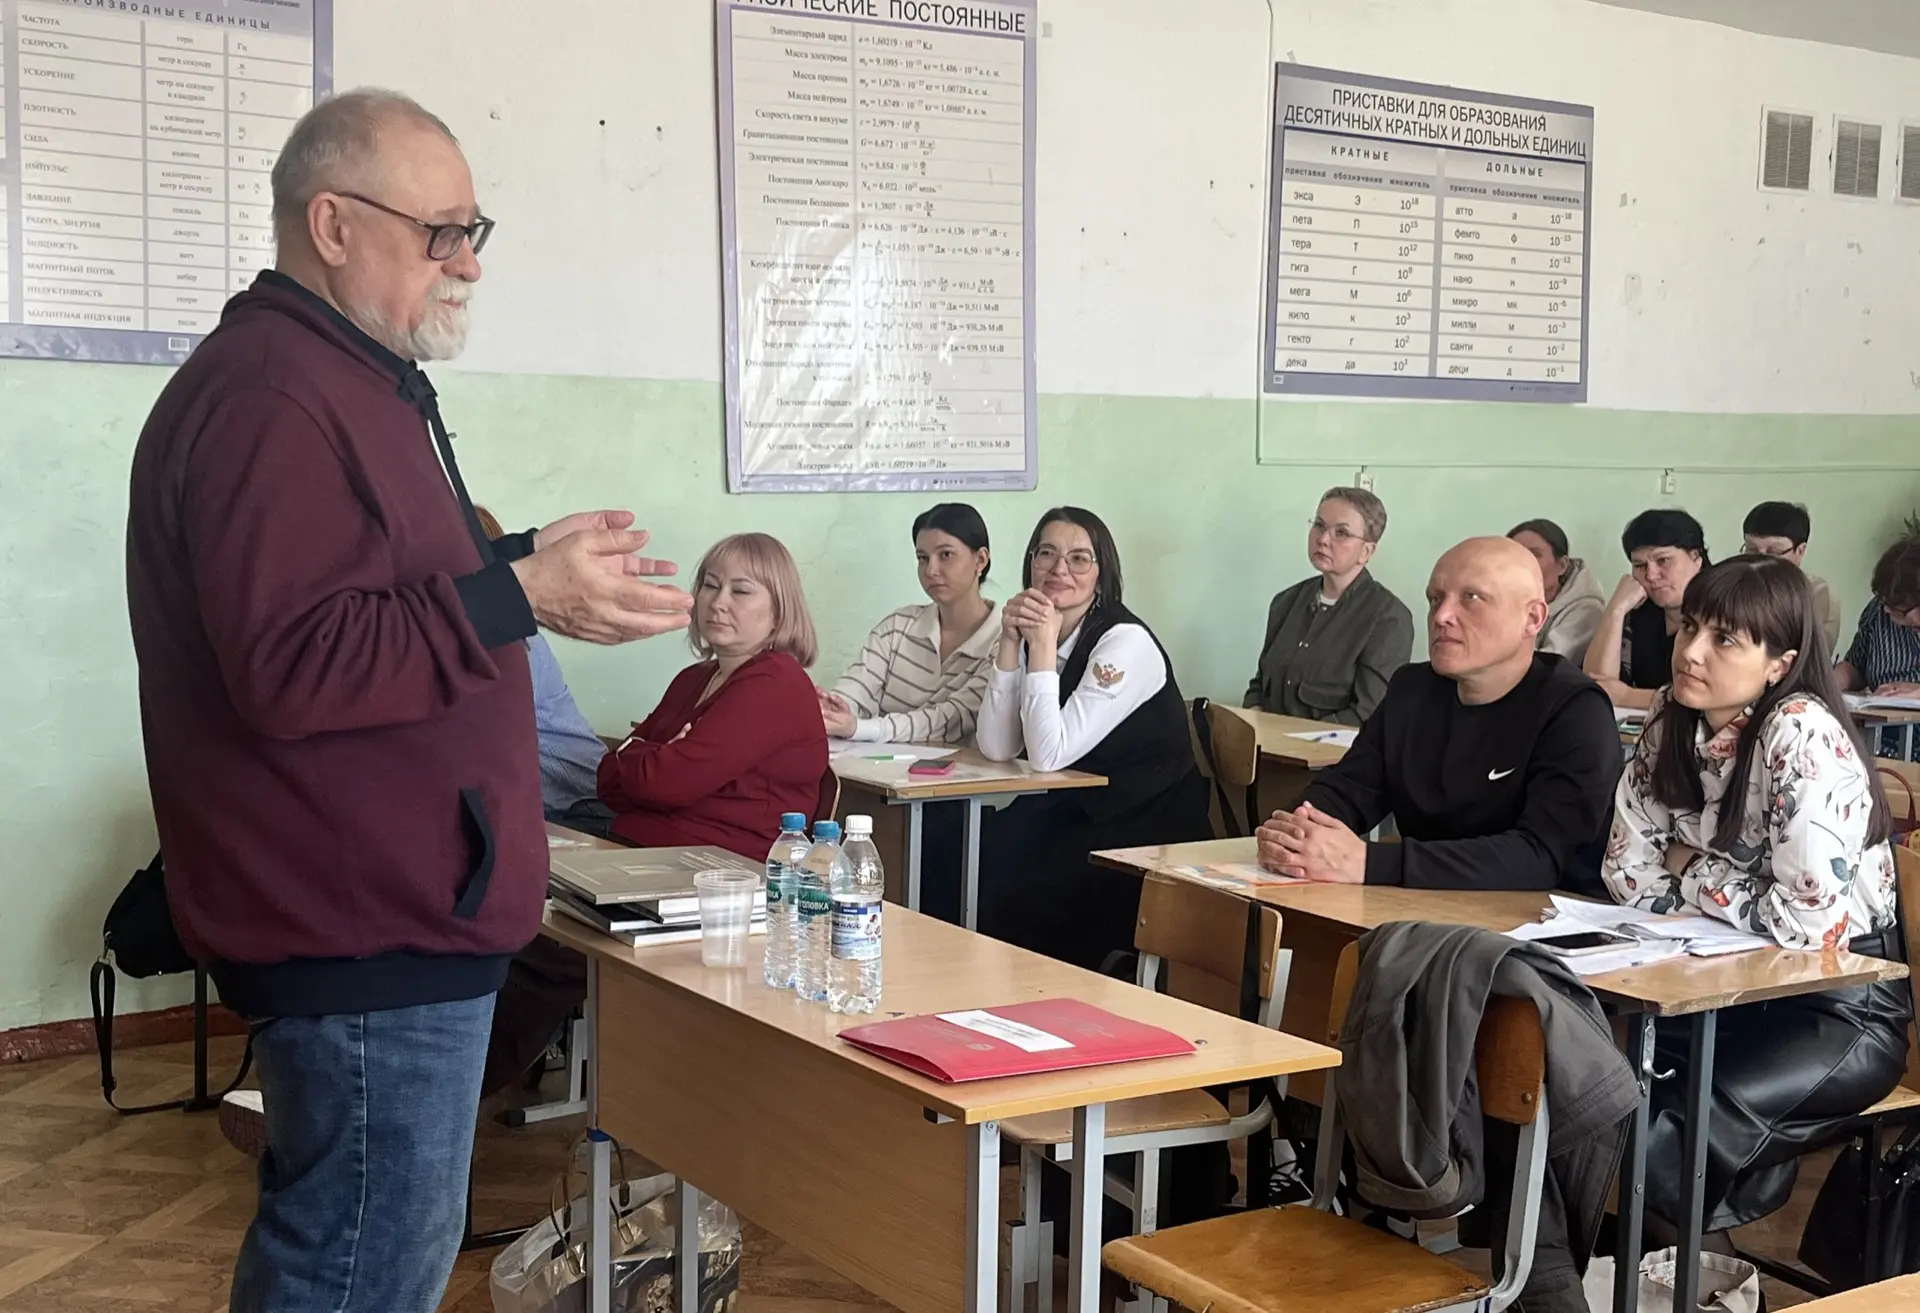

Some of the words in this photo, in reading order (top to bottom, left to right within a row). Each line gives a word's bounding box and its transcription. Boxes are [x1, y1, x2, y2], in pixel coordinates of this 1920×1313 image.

[21, 14, 61, 26] ЧАСТОТА
[61, 0, 185, 19] ОИЗВОДНЫЕ
[195, 11, 270, 30] ЕДИНИЦЫ
[736, 0, 879, 17] ЕСКИЕ
[890, 0, 1026, 33] ПОСТОЯННЫЕ
[21, 38, 69, 50] СКОРОСТЬ
[785, 48, 808, 59] Масса
[23, 67, 76, 81] УСКОРЕНИЕ
[792, 70, 816, 81] Масса
[787, 90, 811, 101] Масса
[23, 103, 77, 116] ПЛОТНОСТЬ
[755, 108, 791, 121] Скорость
[1332, 89, 1415, 116] ПРИСТАВКИ
[1417, 101, 1447, 119] ДЛЯ
[1449, 105, 1547, 132] ОБРАЗОВАНИЯ
[1283, 104, 1382, 133] ДЕСЯТИЧНЫХ
[1385, 117, 1449, 140] КРАТНЫХ
[1452, 126, 1461, 142] И
[1463, 128, 1530, 151] ДОЛЬНЫХ
[1532, 137, 1587, 159] ЕДИНИЦ
[24, 133, 49, 143] СИЛА
[1331, 145, 1389, 162] КРАТНЫЕ
[25, 162, 69, 173] ИМПУЛЬС
[1486, 162, 1544, 178] ДОЛЬНЫЕ
[1285, 167, 1326, 178] приставка
[1333, 172, 1383, 184] обозначение
[1389, 179, 1430, 189] множитель
[1293, 191, 1314, 202] экса
[1450, 184, 1487, 195] приставка
[1492, 188, 1538, 200] обозначение
[1455, 206, 1474, 216] атто
[1292, 214, 1313, 225] пета
[1454, 229, 1481, 240] фемто
[1291, 238, 1312, 251] тера
[1453, 252, 1474, 262] пико
[86, 267, 115, 276] ПОТОК
[1290, 262, 1309, 273] гига
[1452, 275, 1473, 284] нано
[1289, 287, 1311, 297] мега
[1452, 298, 1478, 307] микро
[1288, 311, 1310, 320] кило
[1451, 320, 1477, 329] милли
[1287, 334, 1311, 344] гекто
[1450, 342, 1474, 351] санти
[1286, 357, 1307, 368] дека
[1448, 365, 1469, 374] деци
